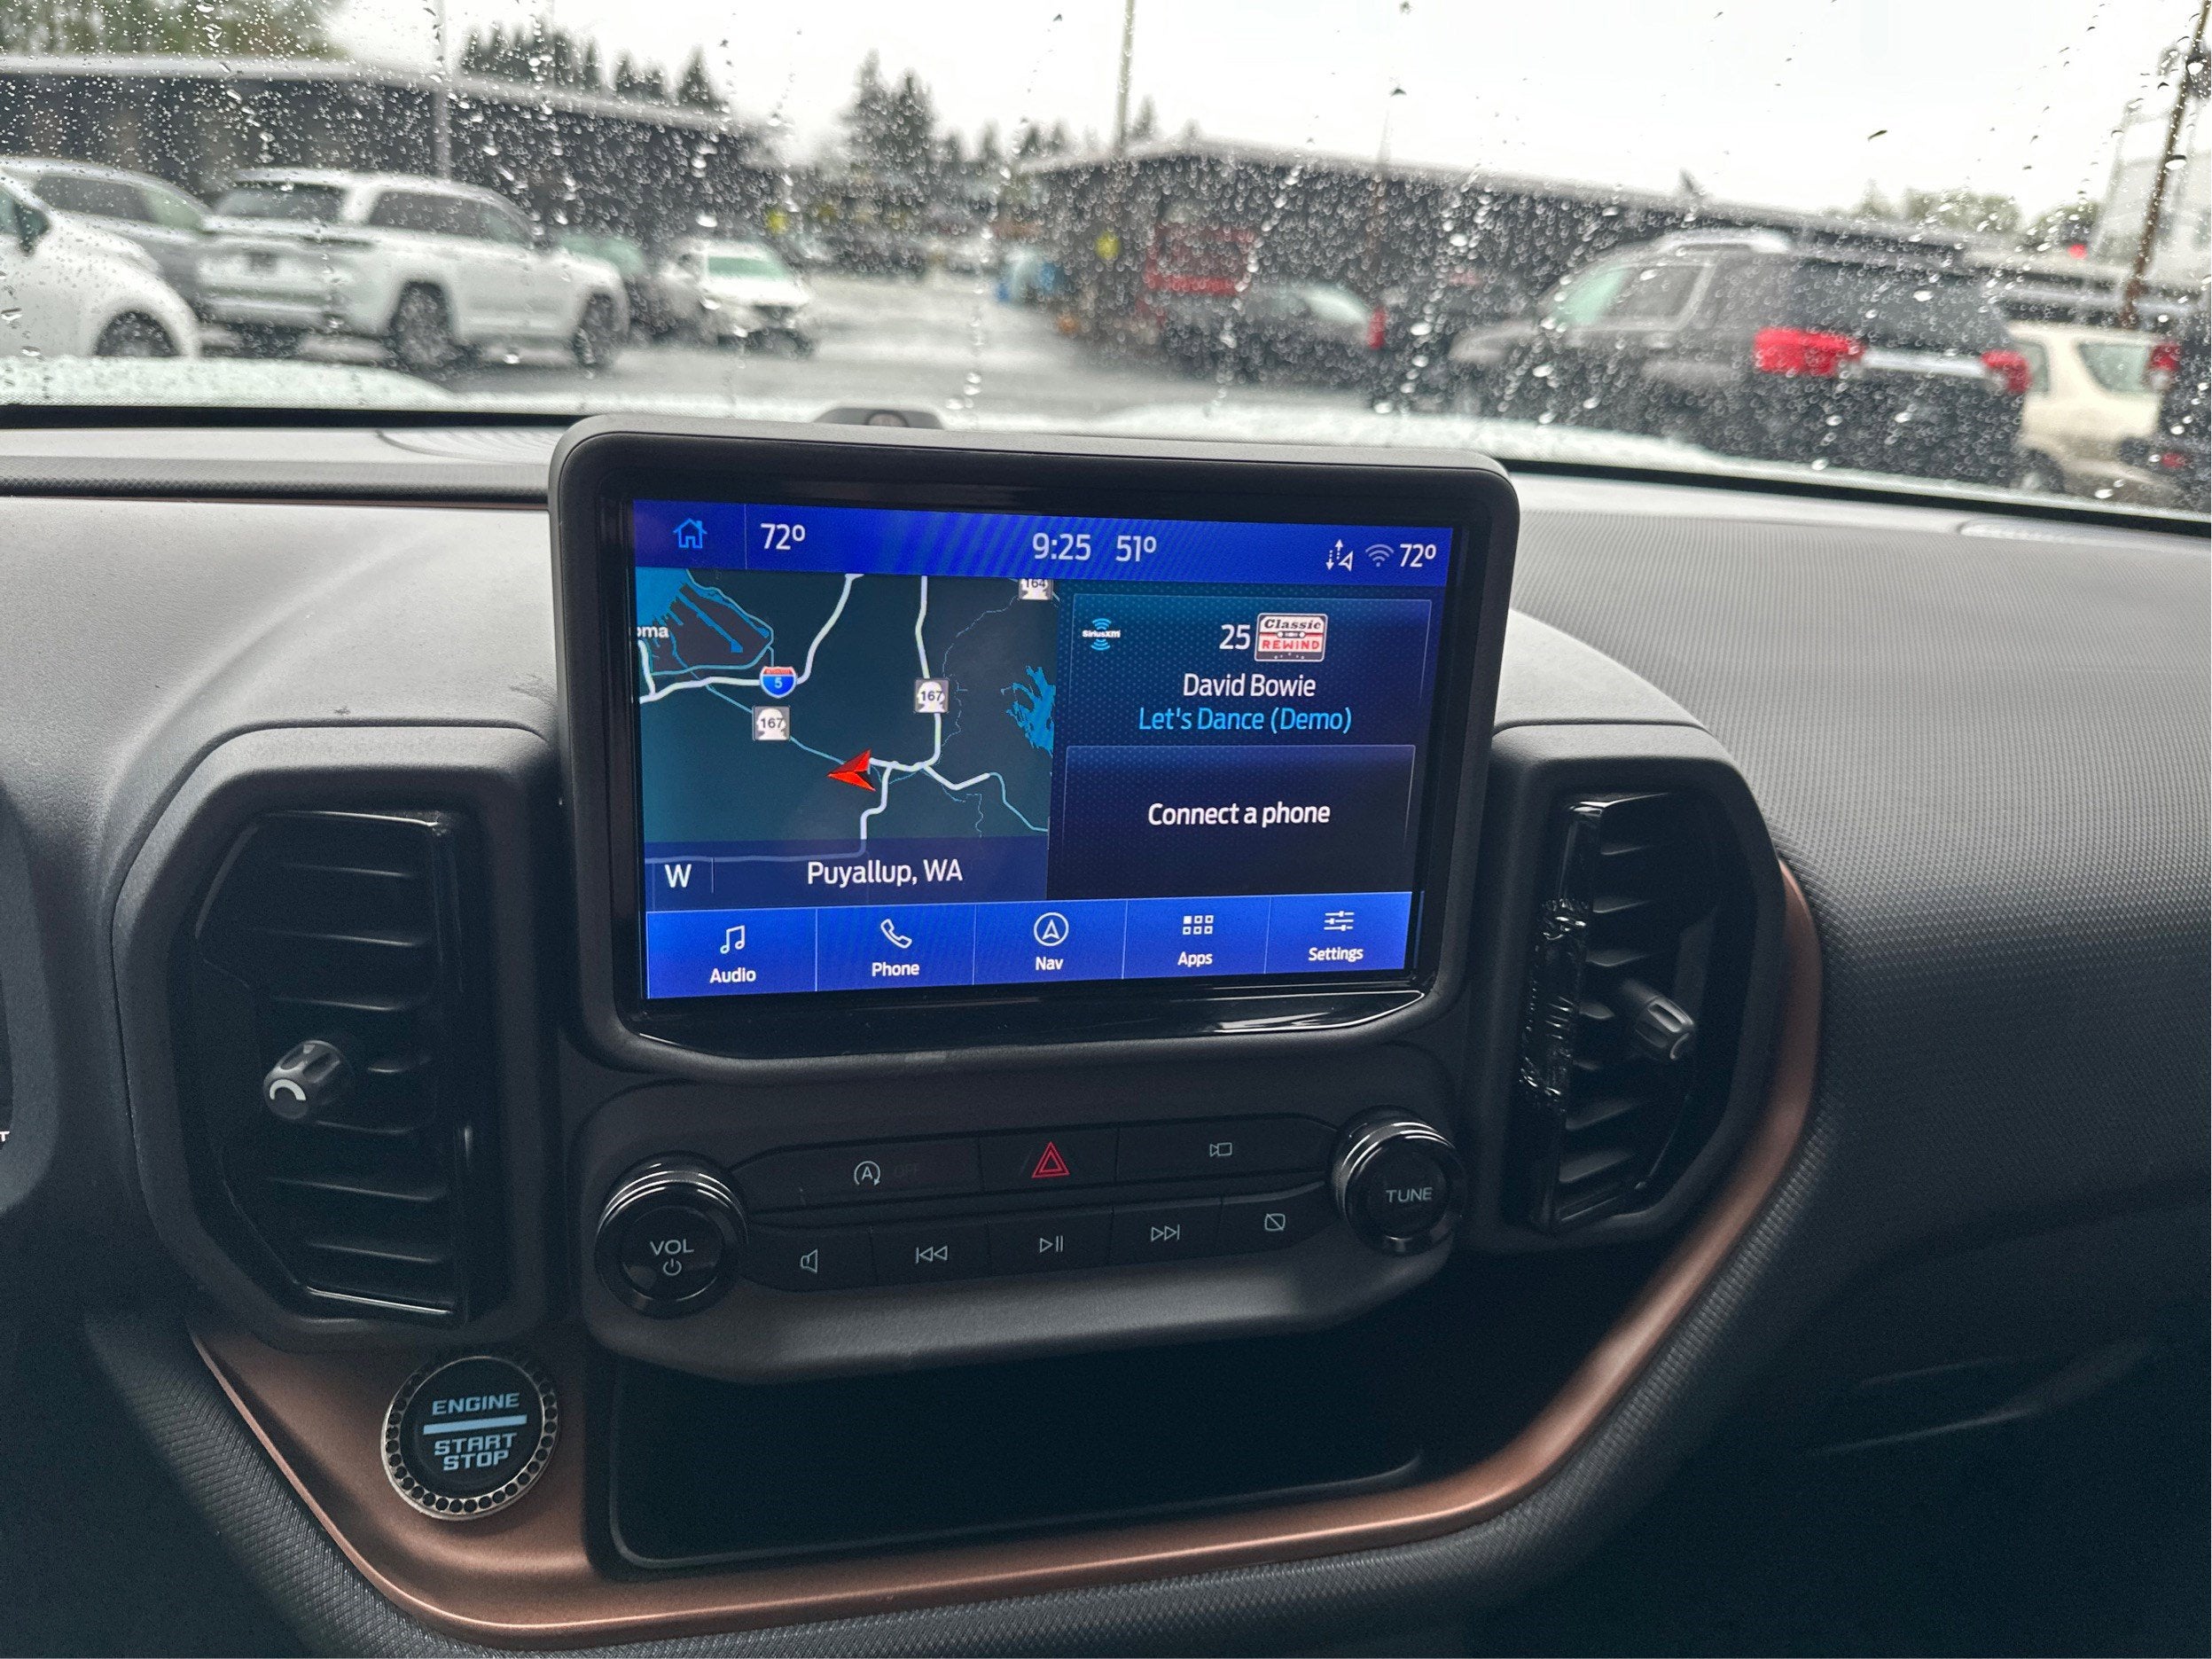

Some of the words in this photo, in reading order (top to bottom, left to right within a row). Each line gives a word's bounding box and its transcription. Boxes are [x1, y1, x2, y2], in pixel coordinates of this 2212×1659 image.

[1032, 532, 1091, 561] 9:25
[1027, 578, 1045, 588] 164
[1263, 619, 1322, 630] Classic
[1219, 623, 1251, 650] 25
[1262, 639, 1320, 650] REWIND
[774, 677, 783, 689] 5
[1183, 672, 1245, 697] David
[1250, 673, 1317, 697] Bowie
[921, 690, 943, 701] 167
[761, 717, 784, 729] 167
[1138, 707, 1192, 730] Let's
[1197, 707, 1264, 730] Dance
[1270, 707, 1352, 734] (Demo)
[1148, 802, 1239, 826] Connect
[1243, 806, 1257, 825] a
[1262, 801, 1331, 828] phone
[664, 864, 692, 888] W
[808, 859, 918, 888] Puyallup,
[923, 858, 964, 882] WA
[1035, 956, 1064, 971] Nav
[1176, 951, 1214, 968] Apps
[1308, 946, 1364, 965] Settings
[709, 966, 757, 984] Audio
[872, 961, 920, 977] Phone
[1385, 1186, 1433, 1204] TUNE
[649, 1239, 694, 1256] VOL
[432, 1392, 520, 1416] ENGINE
[434, 1432, 518, 1456] START
[443, 1449, 510, 1472] STOP
